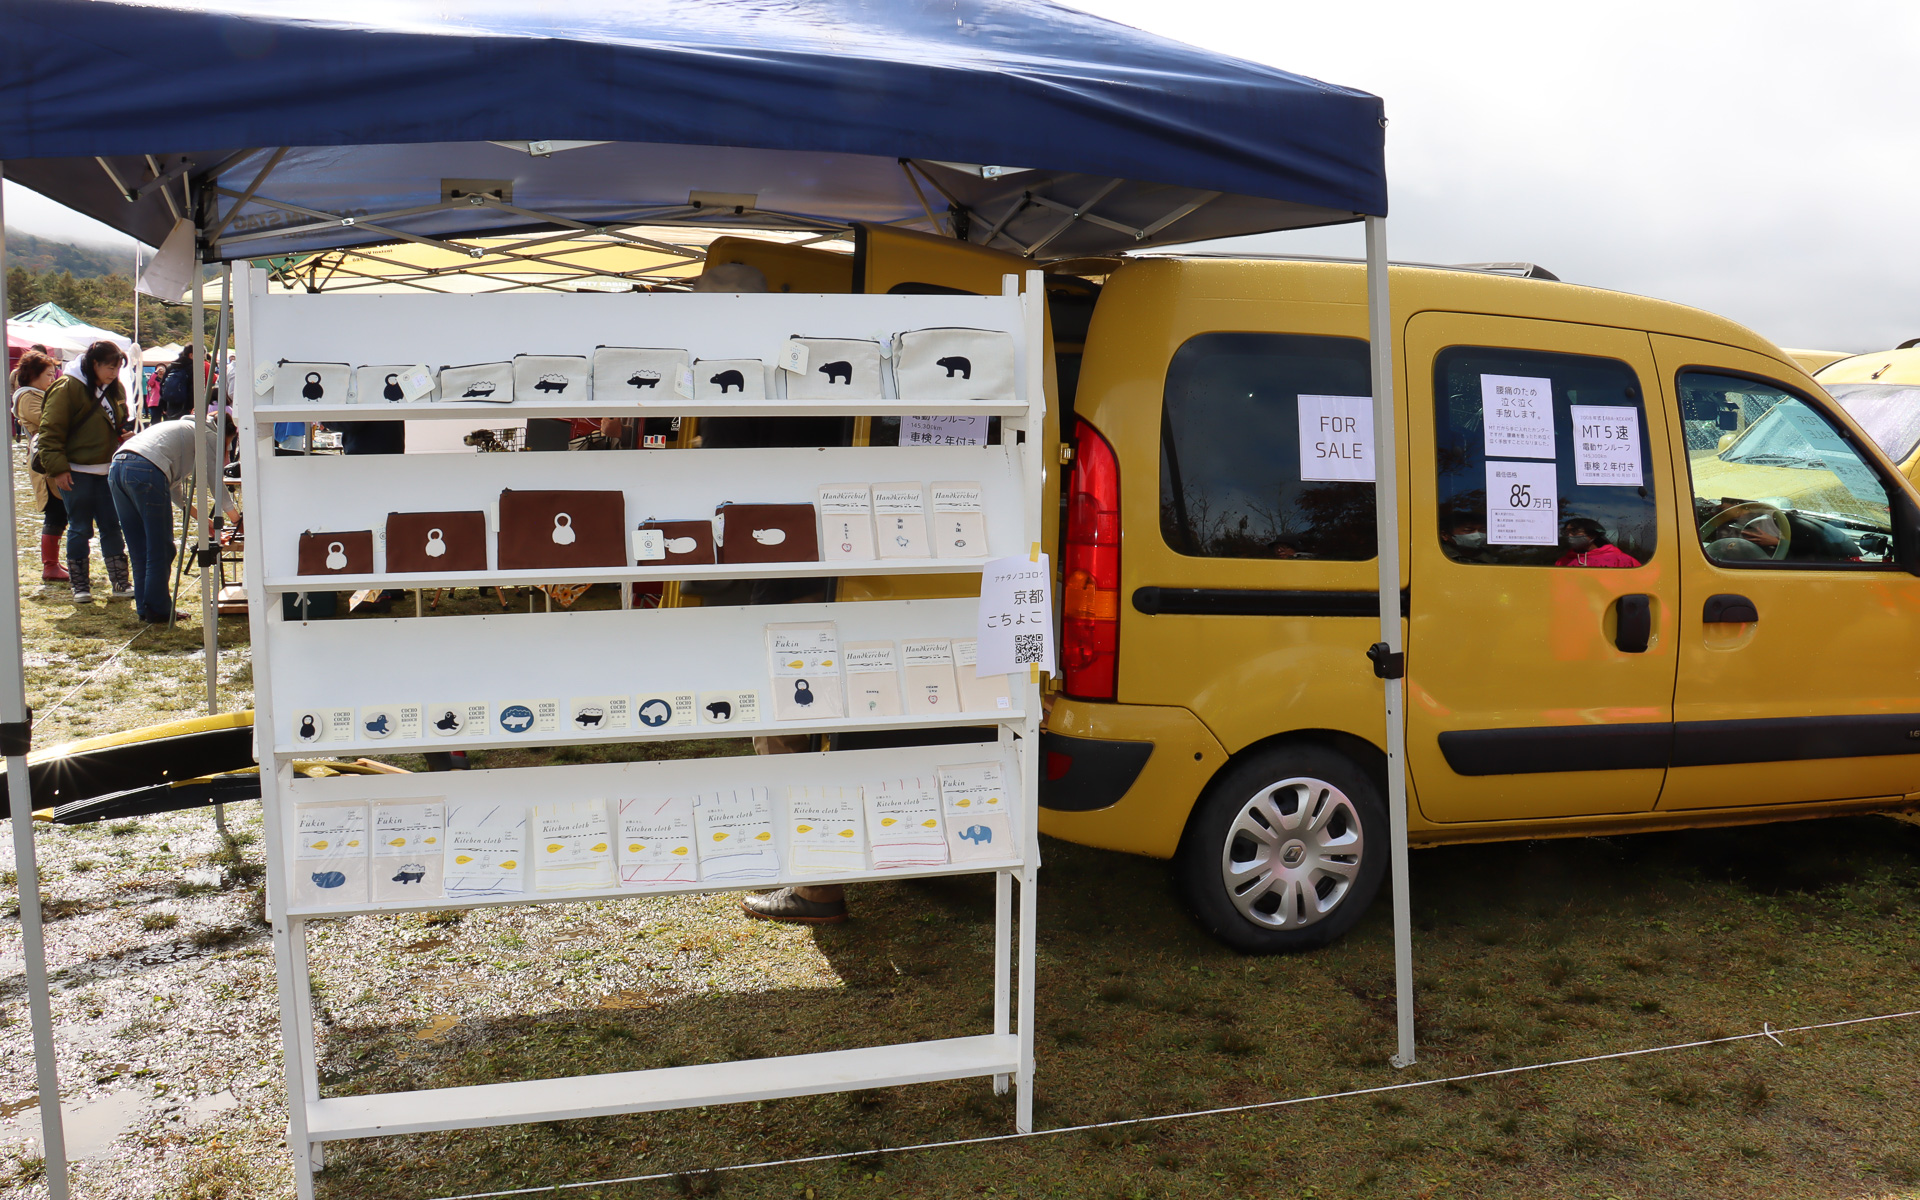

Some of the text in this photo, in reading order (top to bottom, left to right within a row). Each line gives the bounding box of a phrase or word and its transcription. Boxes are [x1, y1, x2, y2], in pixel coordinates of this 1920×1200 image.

[1496, 386, 1537, 396] 腰痛のため
[1501, 398, 1533, 408] 泣く泣く
[1496, 408, 1541, 420] 手放します。
[1320, 416, 1356, 434] FOR
[1316, 442, 1363, 460] SALE
[822, 492, 867, 500] Handkerchief
[876, 493, 920, 501] Handkerchief
[935, 492, 978, 500] Handkerchief
[1014, 589, 1044, 605] 京都
[775, 640, 799, 648] Fukin
[905, 644, 948, 653] Handkerchief
[846, 651, 890, 660] Handkerchief
[300, 819, 326, 828] Fukin
[542, 822, 590, 832] Kitchen cloth
